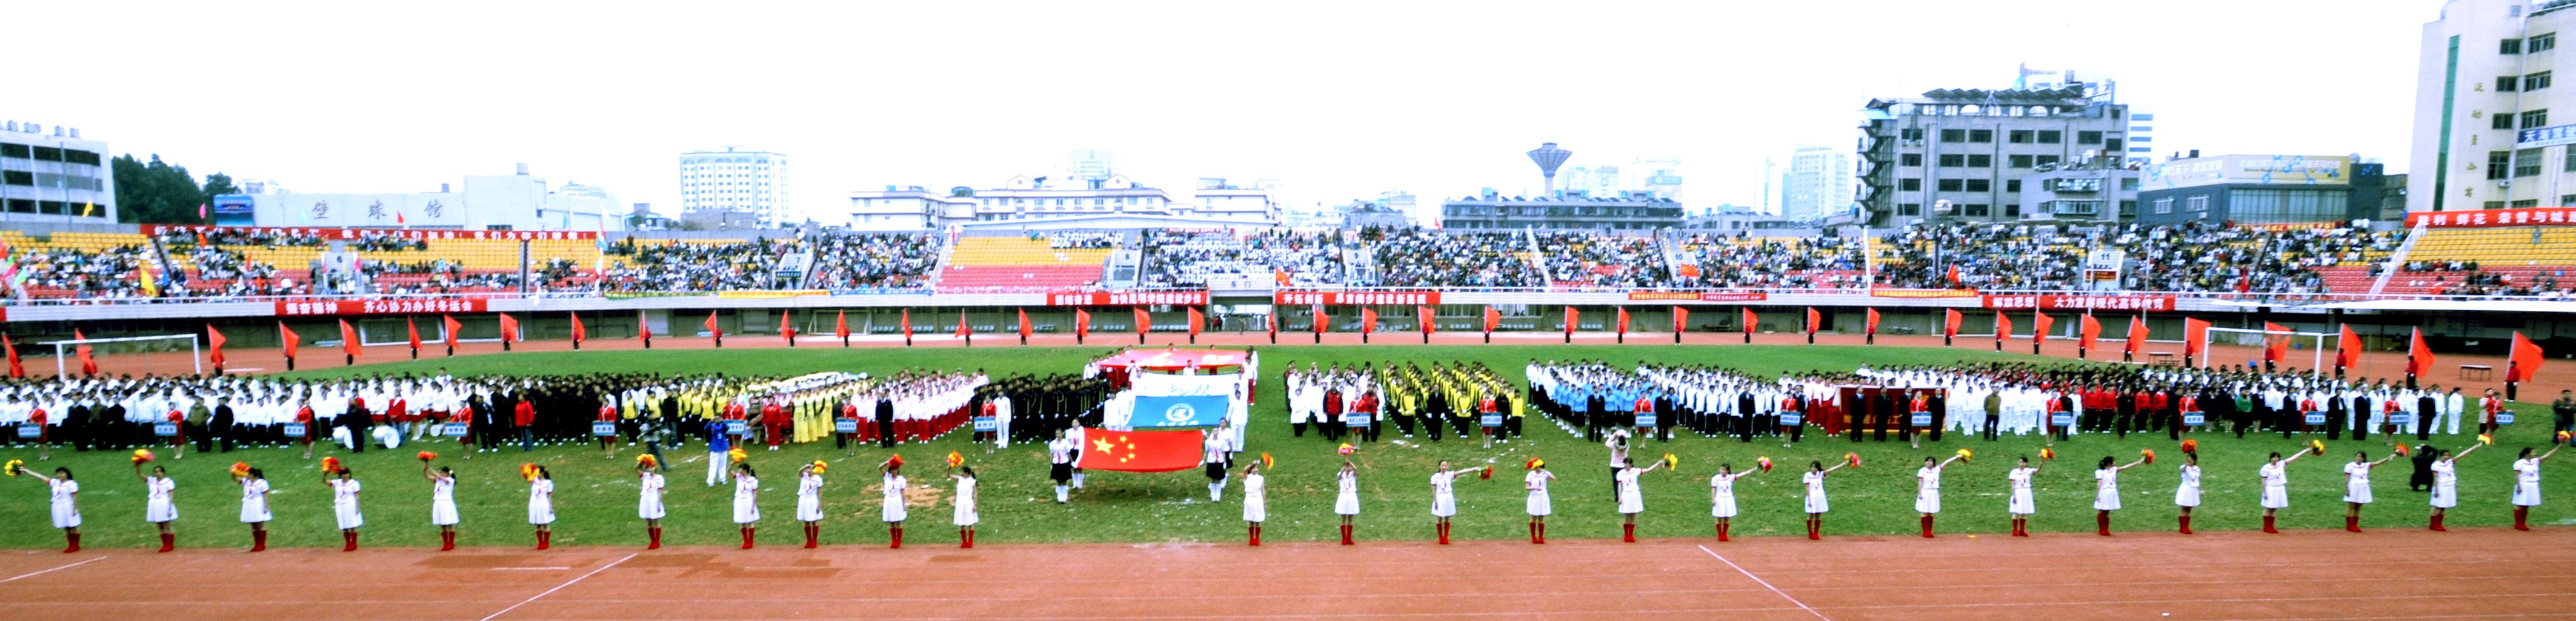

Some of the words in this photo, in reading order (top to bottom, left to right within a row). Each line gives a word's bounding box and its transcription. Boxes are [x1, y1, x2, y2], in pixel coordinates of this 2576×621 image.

[311, 199, 443, 219] 壁球馆
[2456, 213, 2487, 225] 鲜花
[1054, 294, 1093, 305] 团结奋进
[1110, 294, 1202, 304] 加快昆明学院建设步伐
[1283, 294, 1324, 304] 开拓创新
[1992, 297, 2035, 308] 解放思想
[2054, 297, 2165, 310] 大力发展现代高等教育
[285, 302, 338, 314] 振奋精神
[364, 300, 473, 313] 齐心协力办好冬运会
